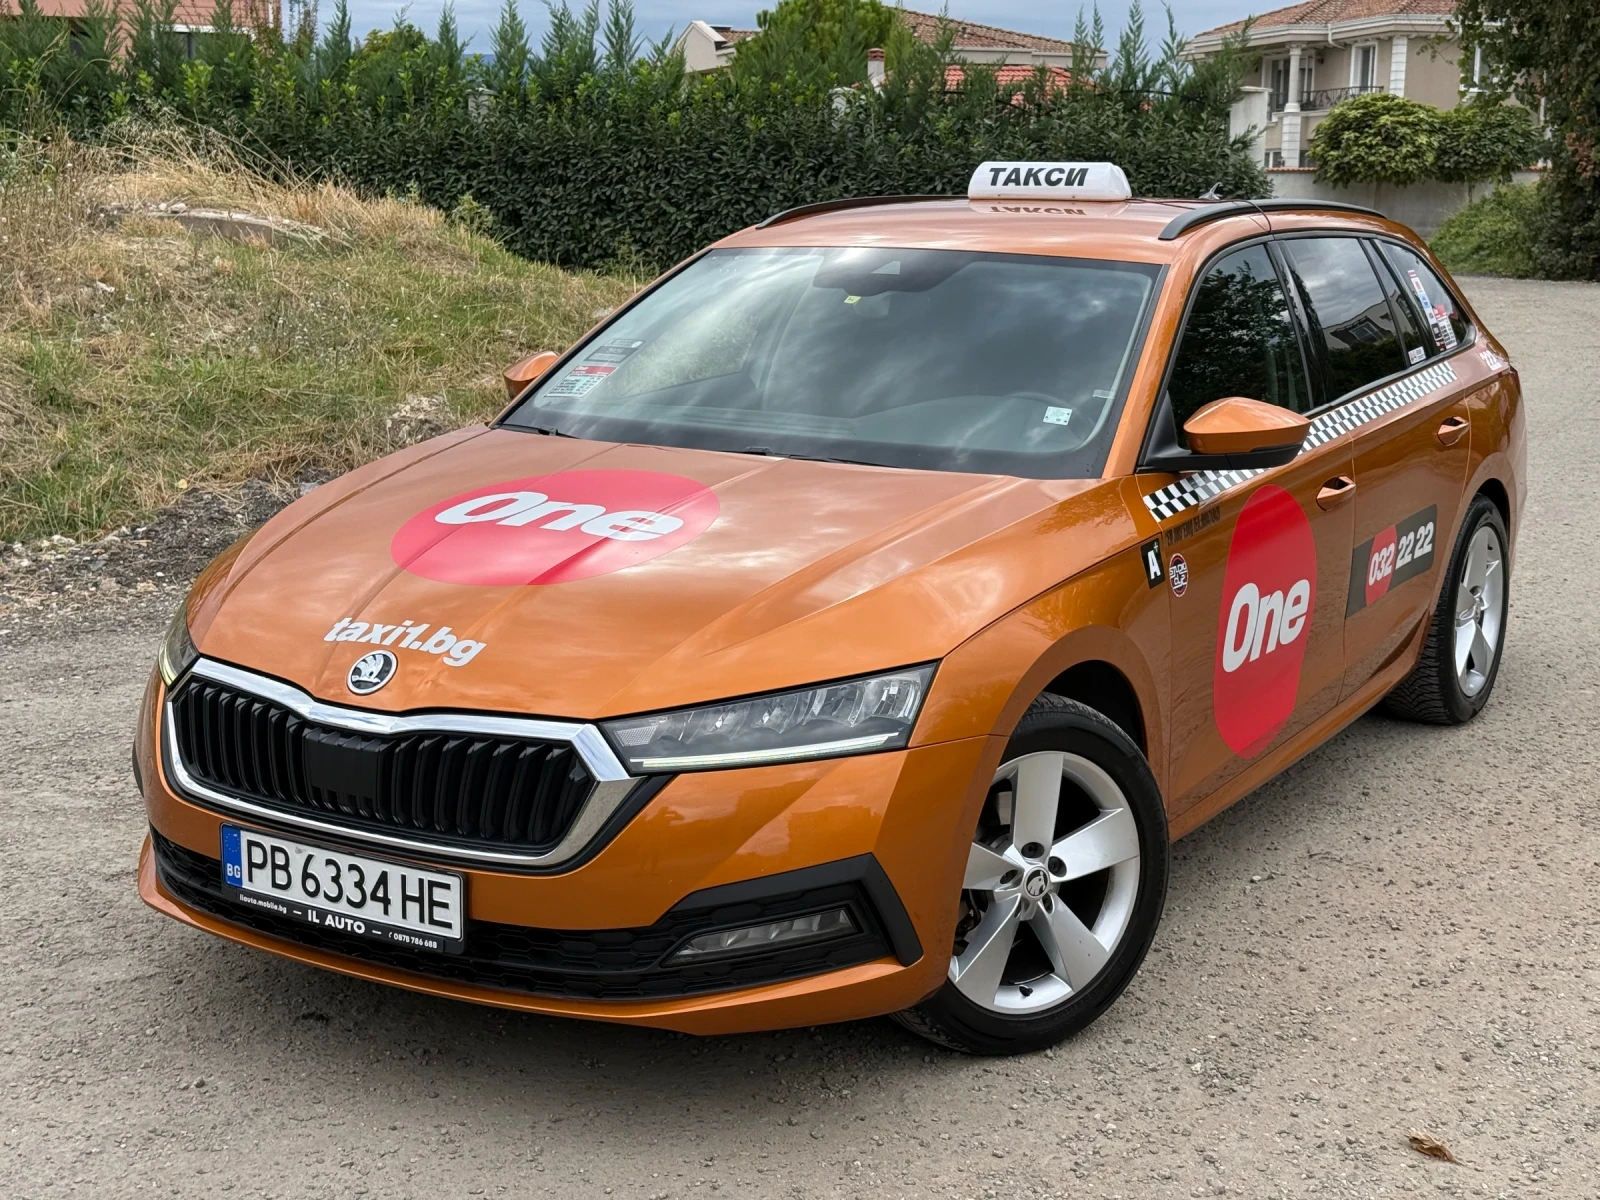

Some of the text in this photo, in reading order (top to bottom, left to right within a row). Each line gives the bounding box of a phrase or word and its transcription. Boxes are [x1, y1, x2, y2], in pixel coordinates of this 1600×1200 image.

[989, 167, 1089, 187] ТАКСИ
[434, 491, 684, 541] One
[1368, 521, 1434, 586] 032 22 22
[323, 617, 488, 667] taxi1.bg
[1222, 579, 1311, 673] One
[226, 863, 241, 879] BG
[246, 838, 453, 930] PB 6334 HE
[307, 909, 320, 924] IL
[324, 914, 366, 934] AUTO
[410, 936, 424, 946] 786
[424, 941, 438, 950] 688
